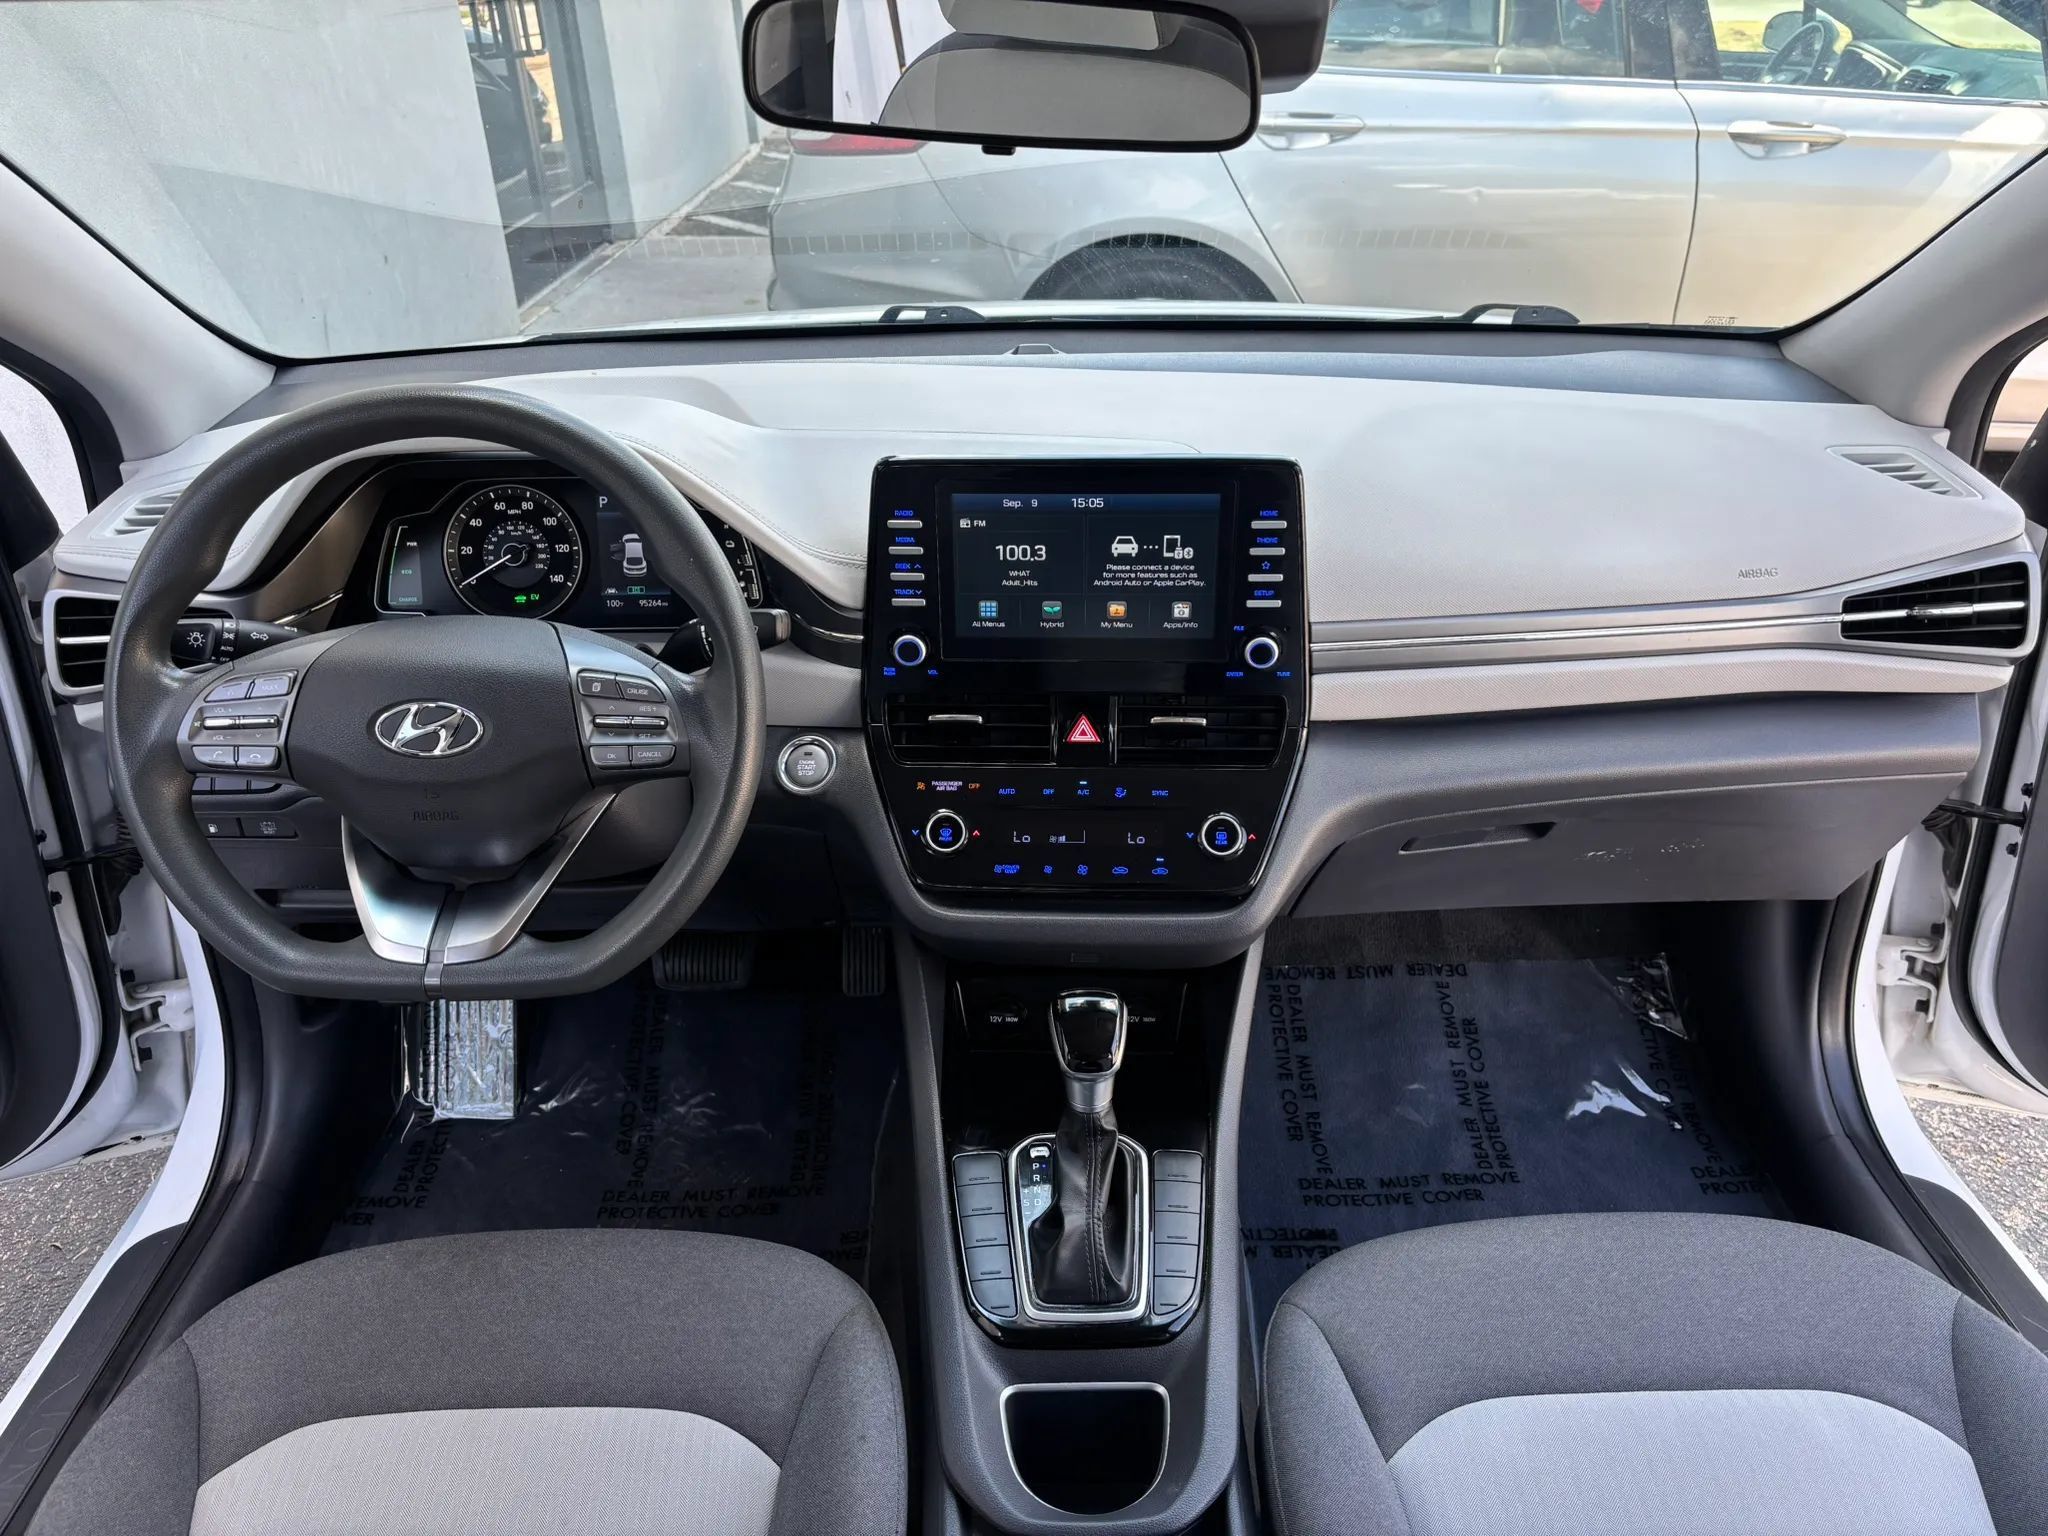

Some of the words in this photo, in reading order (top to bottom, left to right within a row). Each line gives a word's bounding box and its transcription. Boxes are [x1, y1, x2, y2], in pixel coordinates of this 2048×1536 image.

[494, 502, 506, 510] 60
[521, 501, 534, 510] 80
[599, 496, 608, 508] P
[1003, 499, 1023, 508] Sep.
[1031, 499, 1038, 507] 9
[1071, 498, 1104, 508] 15:05
[469, 519, 482, 527] 40
[542, 517, 557, 526] 100
[460, 546, 473, 555] 20
[555, 544, 570, 552] 120
[995, 545, 1047, 561] 100.3
[549, 574, 564, 583] 140
[1737, 567, 1779, 579] AIRBAG
[1264, 966, 1336, 980] REMOVE
[1347, 964, 1394, 980] MUST
[1406, 963, 1468, 977] DEALER
[1286, 984, 1308, 1043] DEALER
[1436, 981, 1463, 1049] REMOVE
[422, 1002, 438, 1068] REMOV
[1462, 1017, 1486, 1073] COVER
[1267, 984, 1294, 1082] PROTECTIVE
[1281, 1089, 1305, 1142] COVER
[1296, 1055, 1318, 1101] MUST
[1450, 1059, 1473, 1107] MUST
[1475, 1080, 1515, 1169] PROTECTIVE
[1305, 1111, 1334, 1175] REMOVE
[1464, 1117, 1494, 1170] DEALER
[1033, 1174, 1040, 1182] R
[1298, 1178, 1367, 1191] DEALER
[1379, 1174, 1431, 1189] MUST
[1442, 1171, 1521, 1186] REMOVE
[602, 1190, 670, 1202] DEALER
[683, 1188, 736, 1201] MUST
[747, 1185, 825, 1200] REMOVE
[1034, 1186, 1041, 1194] N
[1302, 1193, 1414, 1207] PROTECTIVE
[1422, 1189, 1485, 1204] COVER
[597, 1205, 710, 1219] PROTECTIVE
[718, 1202, 781, 1218] COVER
